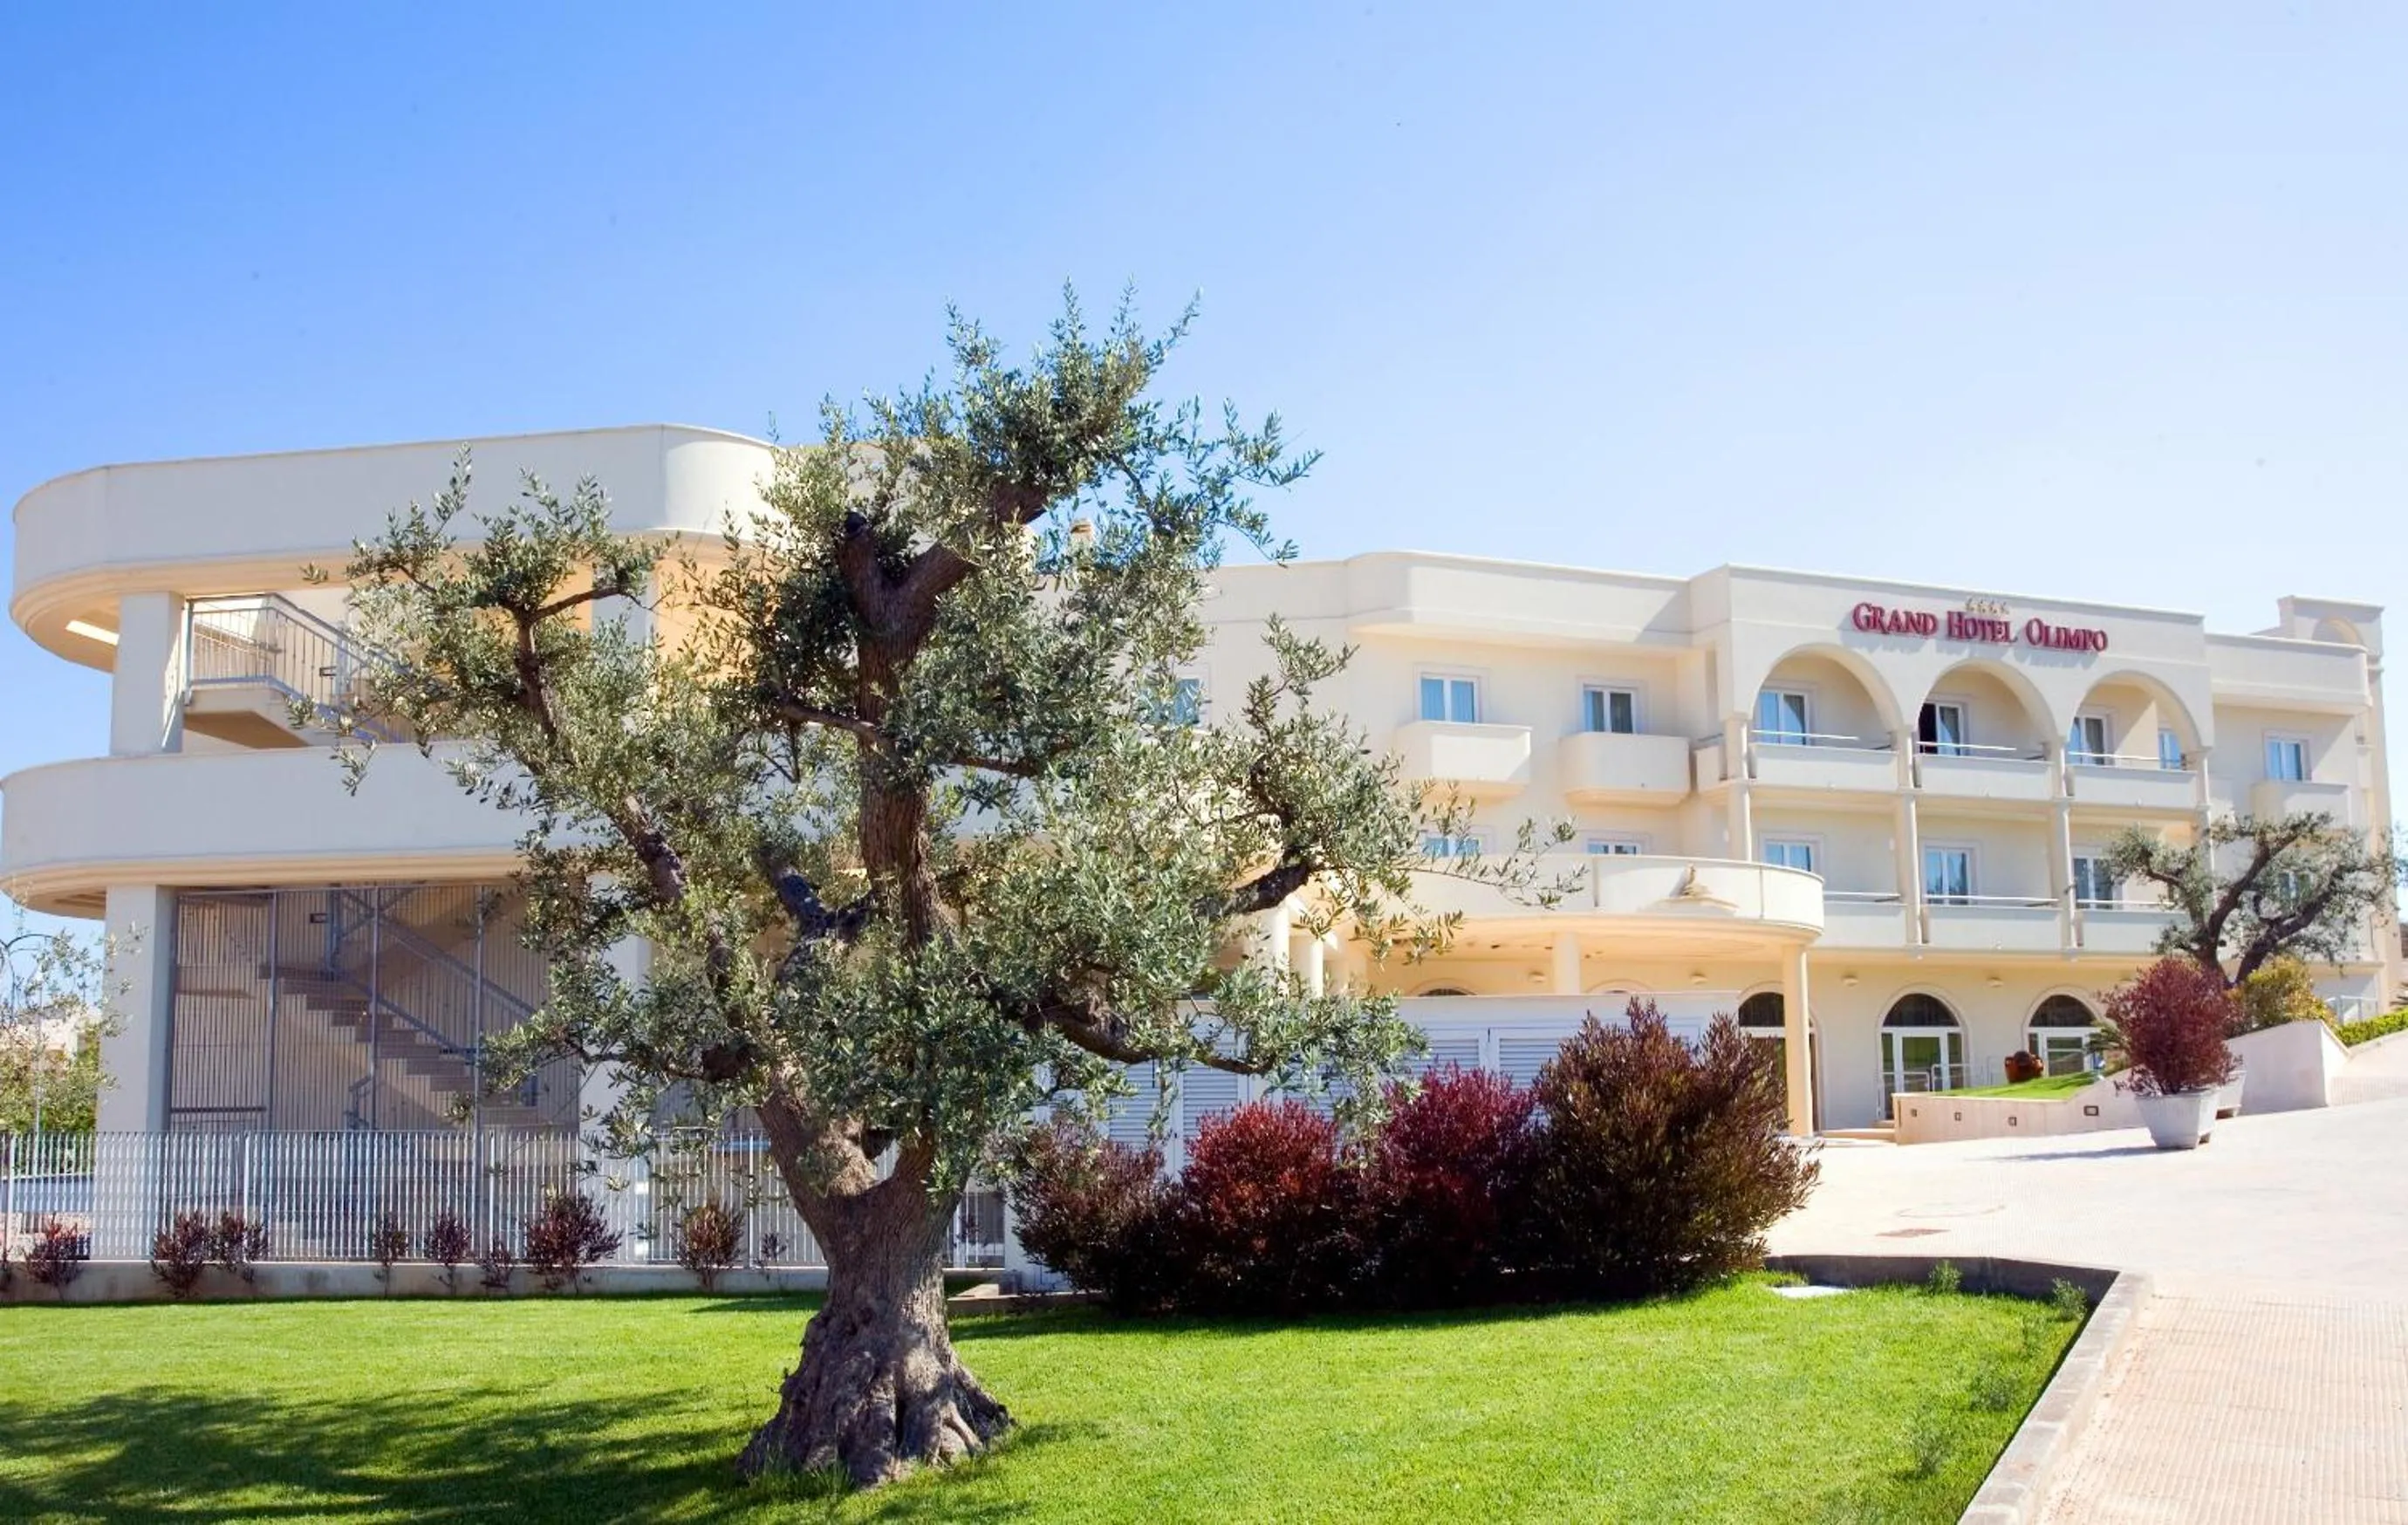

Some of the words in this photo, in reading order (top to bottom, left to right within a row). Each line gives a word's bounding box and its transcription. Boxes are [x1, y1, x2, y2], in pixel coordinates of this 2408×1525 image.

[1852, 602, 1939, 635] GRAND
[1947, 611, 2018, 644] HOTEL
[2026, 618, 2109, 652] OLIMPO
